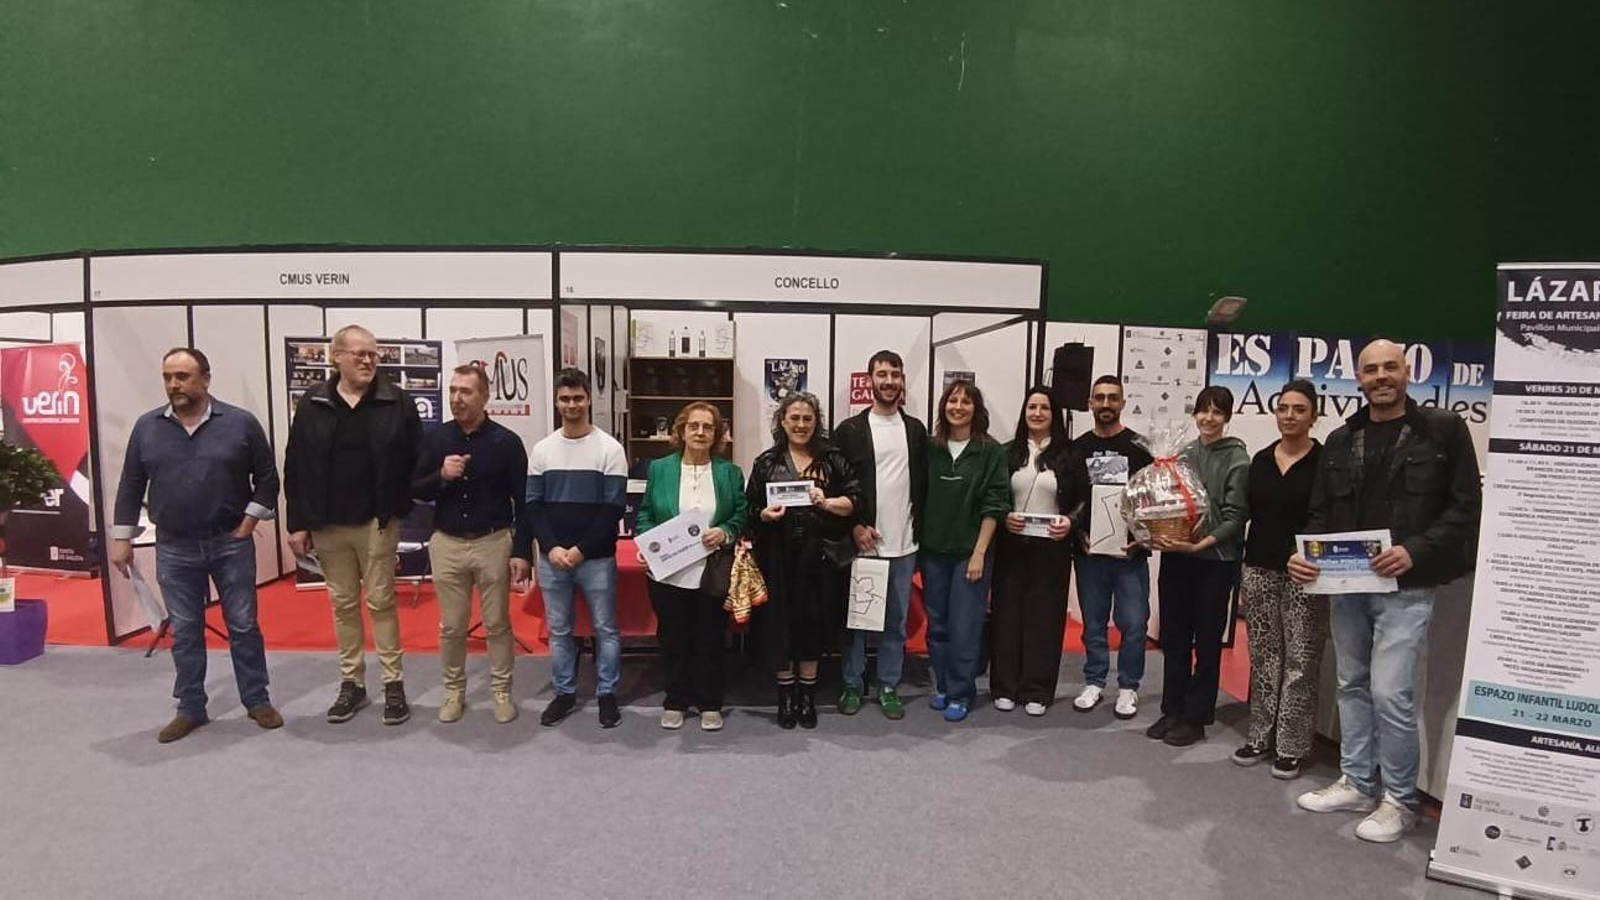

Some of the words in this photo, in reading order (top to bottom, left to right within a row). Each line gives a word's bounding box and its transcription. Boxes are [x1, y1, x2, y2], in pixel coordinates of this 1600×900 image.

[279, 273, 312, 285] CMUS
[315, 273, 350, 285] VERIN
[774, 276, 840, 289] CONCELLO
[1506, 311, 1537, 320] FEIRA
[1539, 311, 1553, 320] DE
[1215, 333, 1271, 377] ES
[1296, 337, 1433, 384] PAO
[1453, 362, 1485, 387] DE
[1525, 384, 1563, 393] VENRES
[1565, 386, 1577, 394] 20
[1579, 386, 1592, 394] DE
[1519, 442, 1561, 452] SÁBADO
[1563, 445, 1574, 453] 21
[1577, 445, 1590, 454] DE
[1474, 686, 1515, 701] ESPAZO
[1517, 692, 1564, 709] INFANTIL
[1512, 708, 1525, 717] 21
[1535, 713, 1549, 722] 22
[1552, 715, 1592, 728] MARZO
